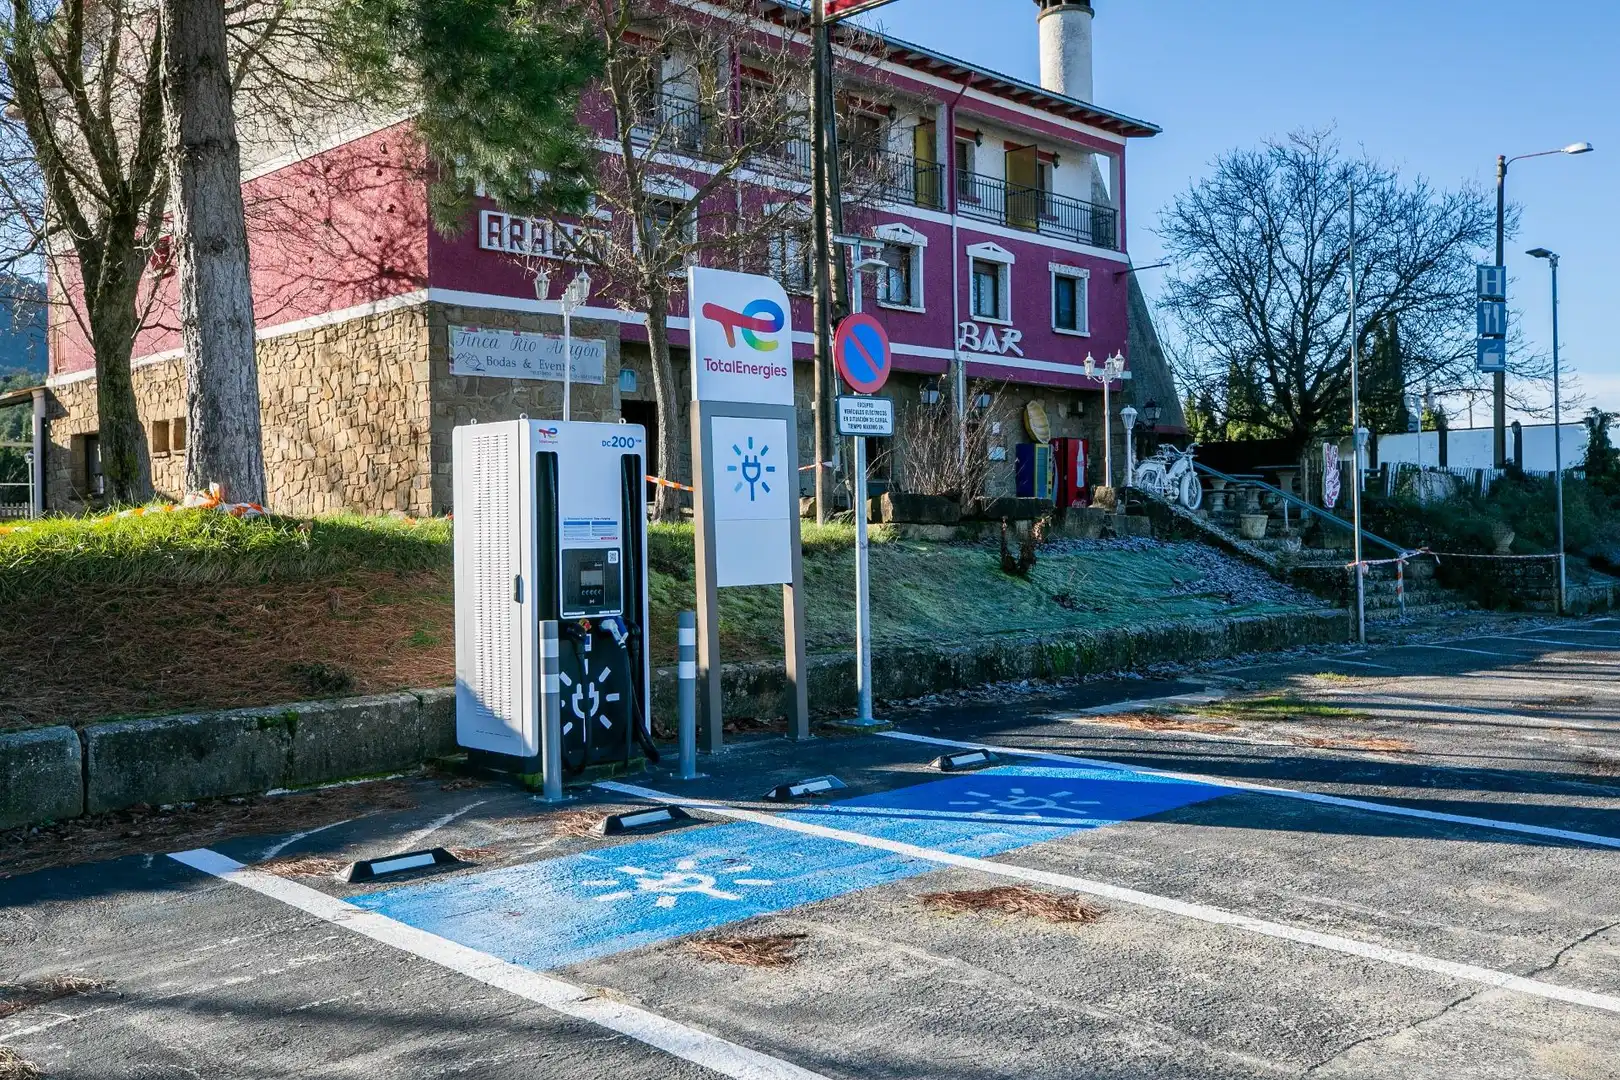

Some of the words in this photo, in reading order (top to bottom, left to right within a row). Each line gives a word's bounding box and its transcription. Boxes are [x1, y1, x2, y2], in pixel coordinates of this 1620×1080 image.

[479, 209, 613, 267] ARAG
[1480, 268, 1504, 295] H
[959, 321, 1024, 357] BAR
[486, 356, 517, 368] Bodas
[522, 360, 532, 369] &
[539, 359, 576, 372] Events
[703, 358, 788, 379] TotalEnergies
